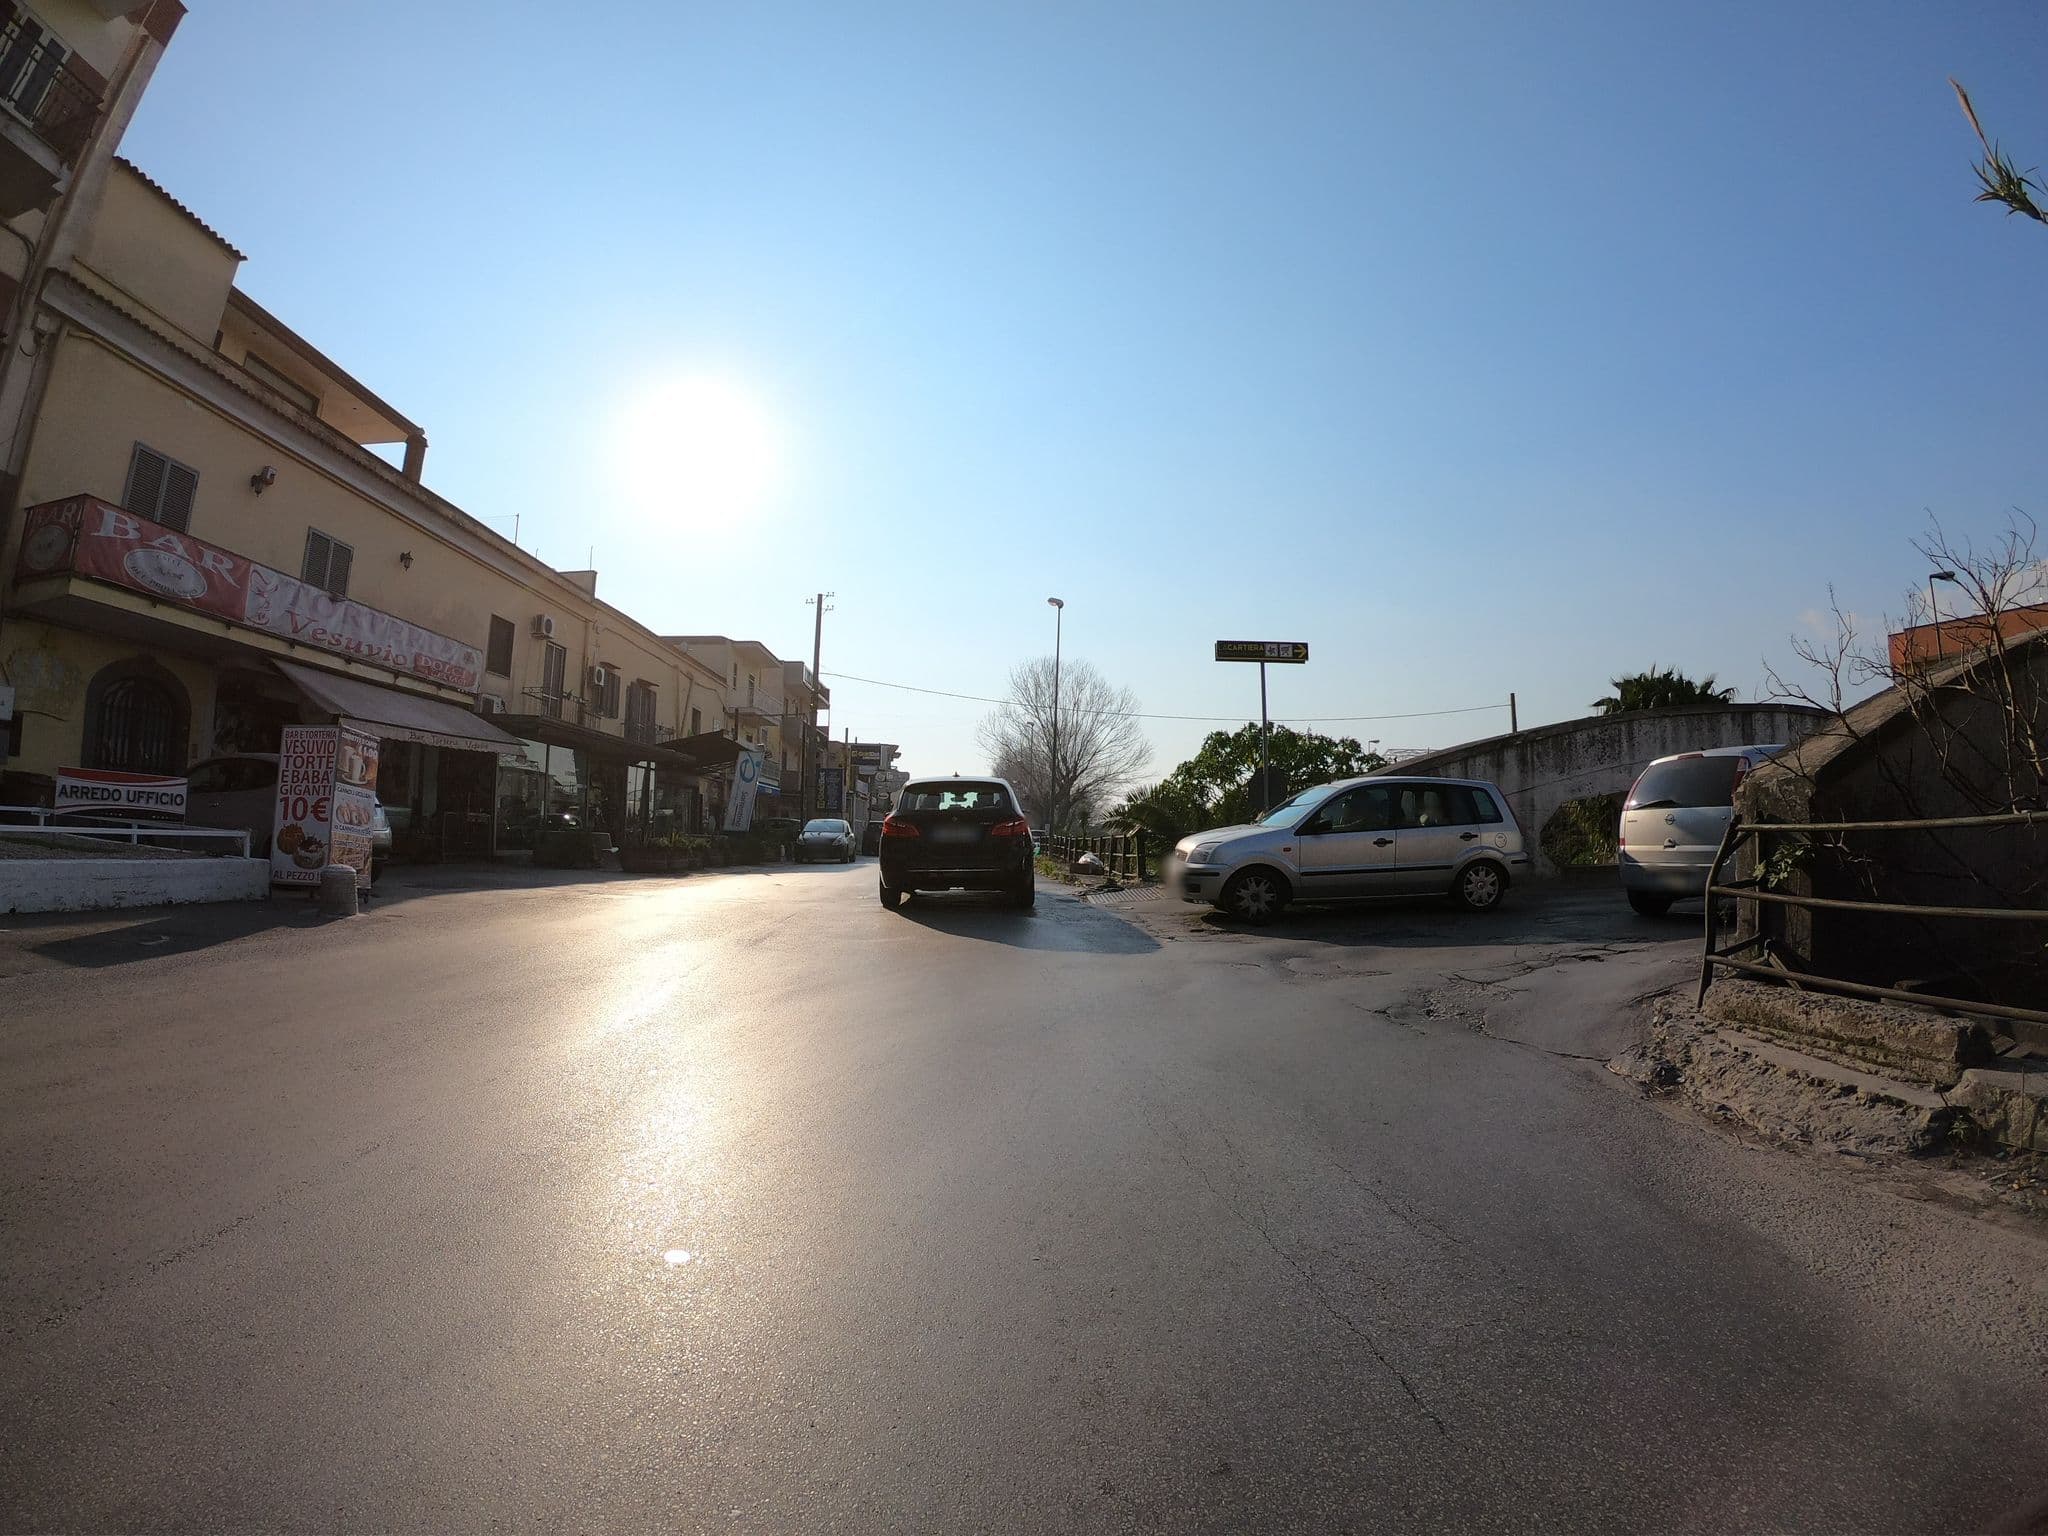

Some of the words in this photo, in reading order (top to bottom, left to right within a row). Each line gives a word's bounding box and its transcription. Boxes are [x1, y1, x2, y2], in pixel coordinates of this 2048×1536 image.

[90, 505, 240, 588] BAR
[285, 609, 408, 666] Vesuvio
[421, 655, 468, 679] DOLCI
[285, 731, 299, 740] BAR
[285, 740, 336, 755] VESUVIO
[283, 755, 335, 770] TORTE
[281, 769, 289, 784] E
[58, 784, 122, 802] ARREDO
[127, 789, 185, 806] UFFICIO
[280, 784, 332, 797] GIGANTI
[273, 870, 285, 881] AL
[286, 870, 315, 881] PEZZO
